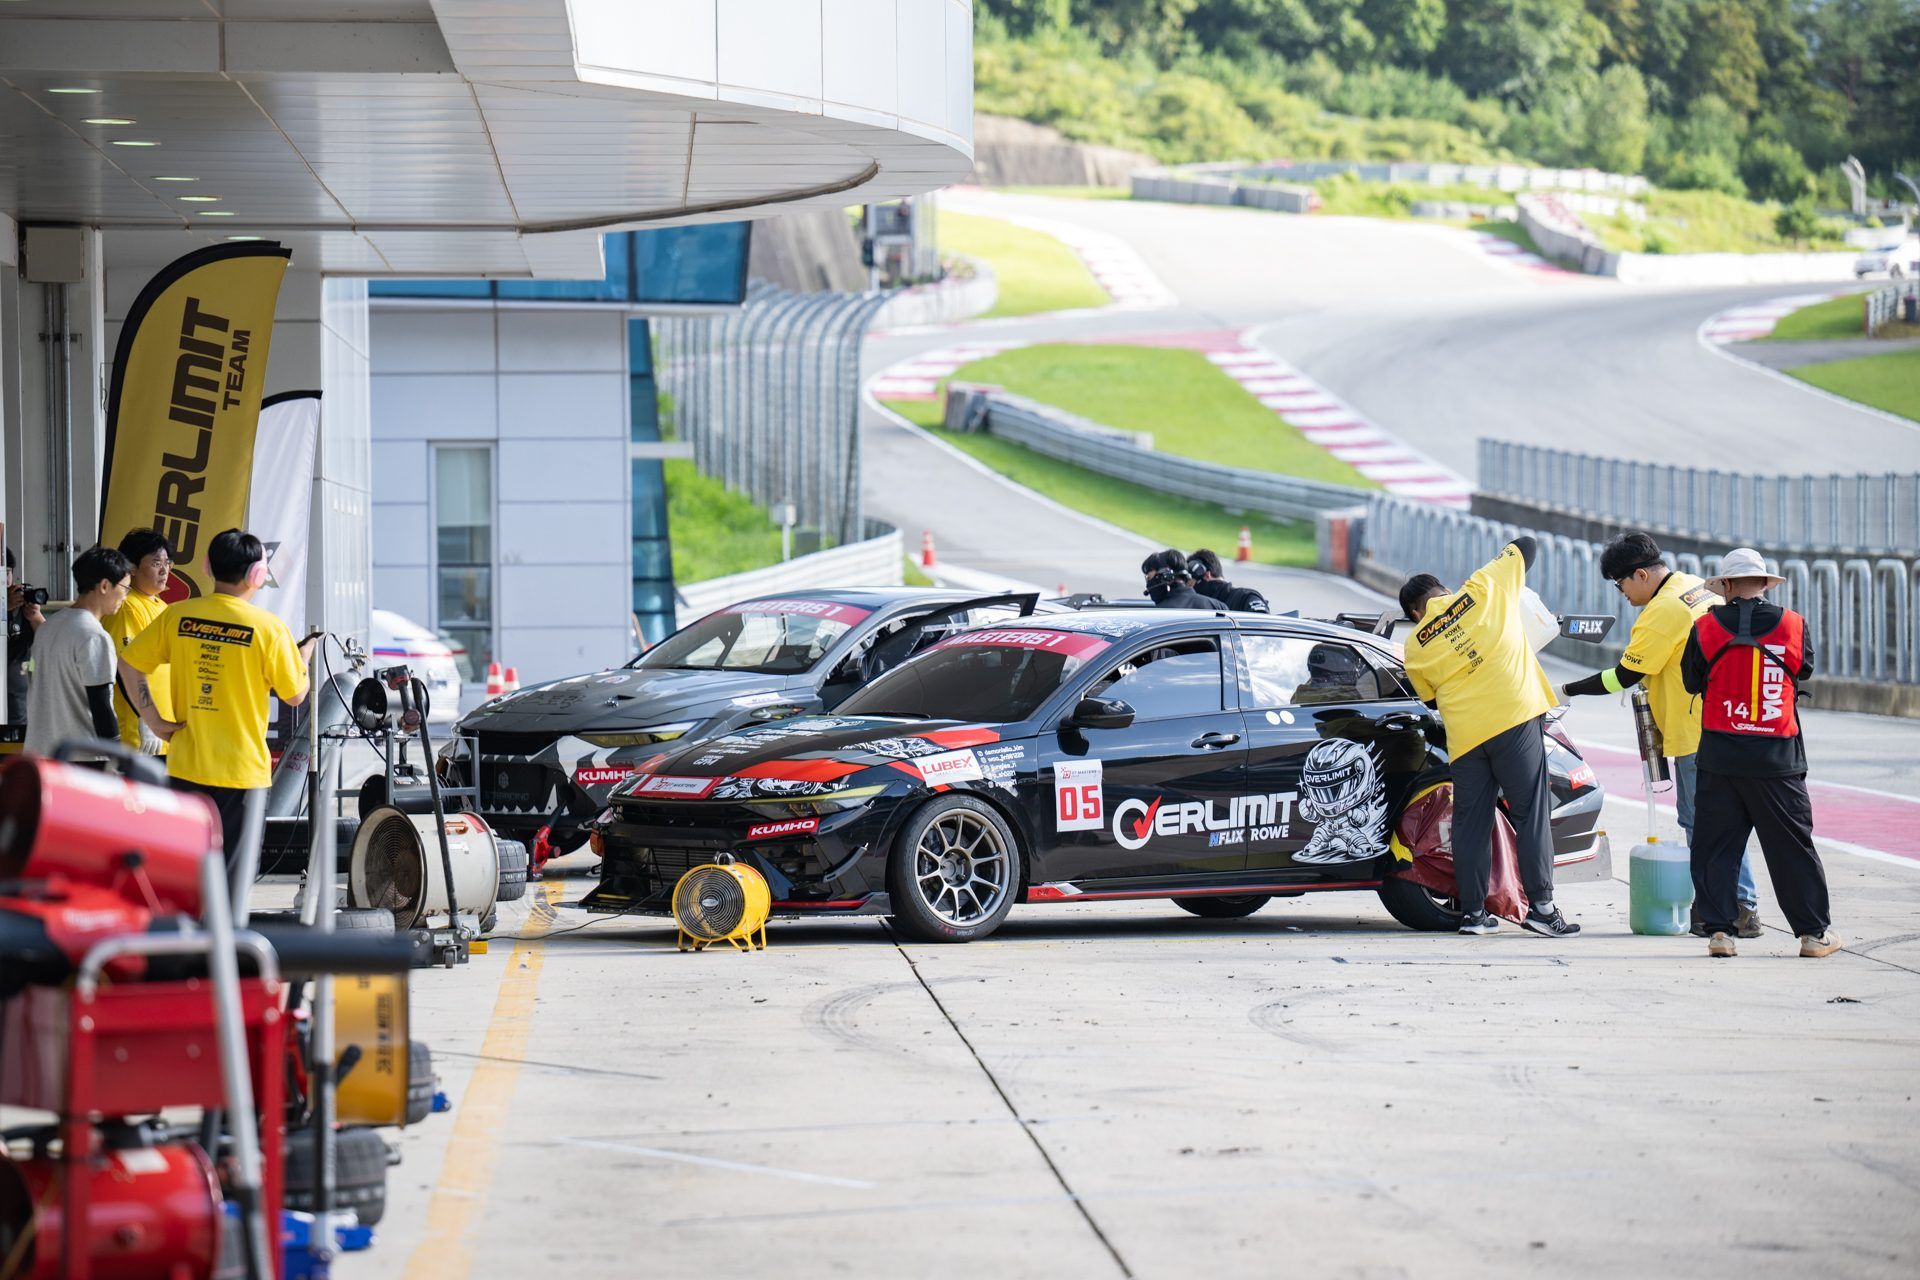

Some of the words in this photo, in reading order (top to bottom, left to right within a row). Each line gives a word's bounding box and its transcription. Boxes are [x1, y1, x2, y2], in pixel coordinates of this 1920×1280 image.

[222, 329, 251, 411] TEAM
[152, 296, 230, 600] ERLIMIT
[824, 605, 845, 617] 1
[1419, 597, 1469, 641] OVERLIMIT
[180, 619, 252, 640] OVERLIMIT
[1444, 624, 1463, 640] ROWE
[1568, 619, 1603, 635] NFLIX
[943, 631, 1047, 646] MASTERS
[1046, 635, 1067, 647] 1
[1761, 644, 1786, 722] MEDIA
[1723, 700, 1750, 719] 14
[921, 756, 974, 775] LUBEX
[1305, 767, 1352, 783] OVERLIMIT
[1059, 784, 1101, 821] 05
[750, 820, 816, 837] KUMHO
[1208, 829, 1245, 848] NFLIX
[1250, 825, 1290, 842] ROWE
